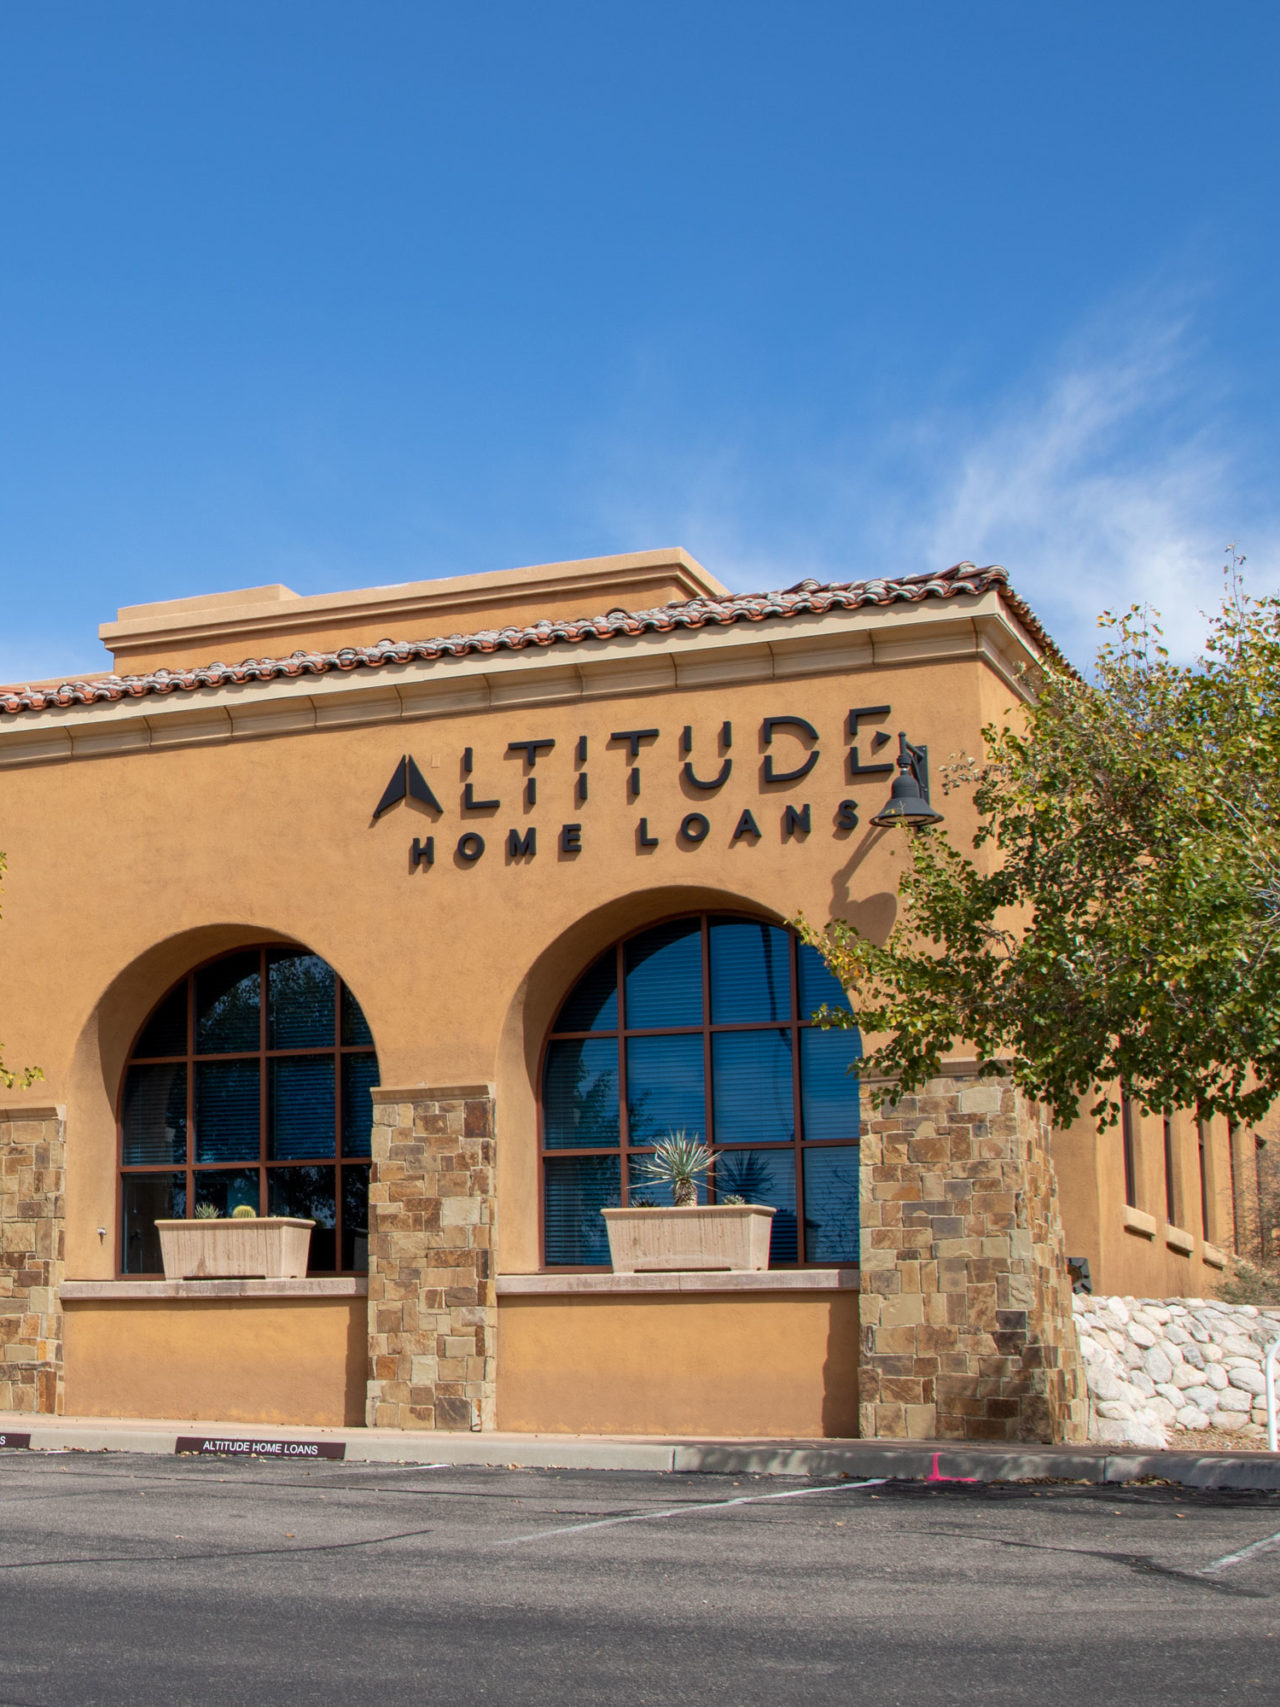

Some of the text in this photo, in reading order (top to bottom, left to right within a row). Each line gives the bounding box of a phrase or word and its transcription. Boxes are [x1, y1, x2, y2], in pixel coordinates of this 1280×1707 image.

[373, 705, 895, 819] ALTITUDE
[412, 799, 860, 866] HOME LOANS
[203, 1441, 319, 1455] ALTITUDE HOME LOANS
